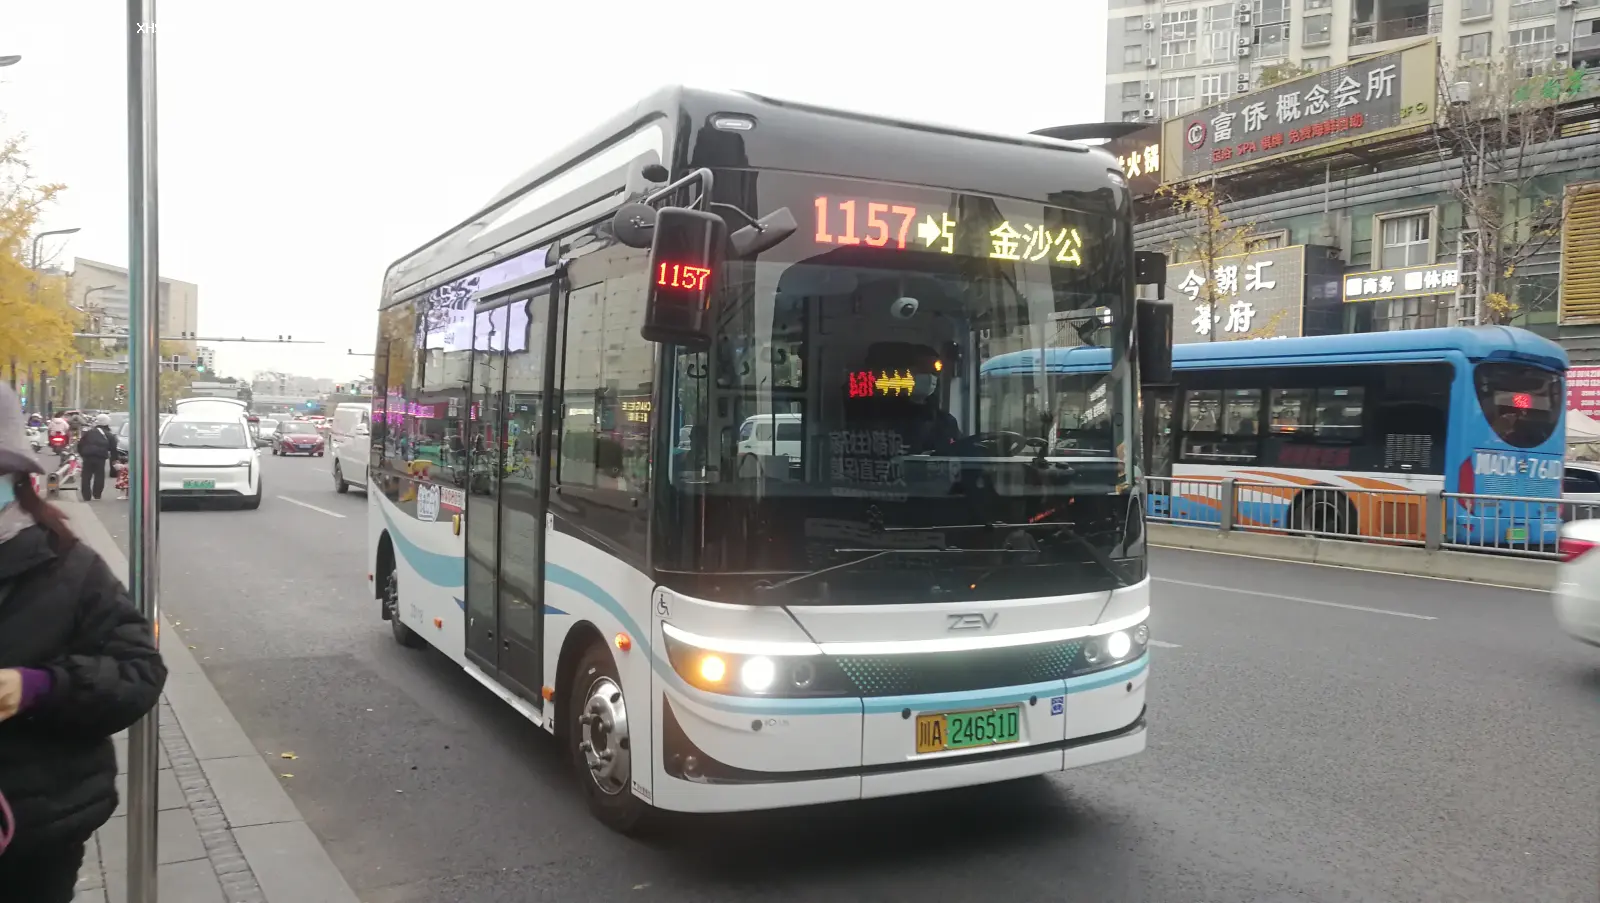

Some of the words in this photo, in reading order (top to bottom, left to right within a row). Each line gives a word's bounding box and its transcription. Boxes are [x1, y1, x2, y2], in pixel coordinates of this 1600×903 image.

[1211, 64, 1397, 144] 富侨概念会所
[1236, 141, 1257, 156] SPA
[814, 196, 917, 249] 1157
[988, 221, 1083, 266] 金沙公
[658, 262, 711, 291] 1157
[947, 612, 999, 631] ZEV
